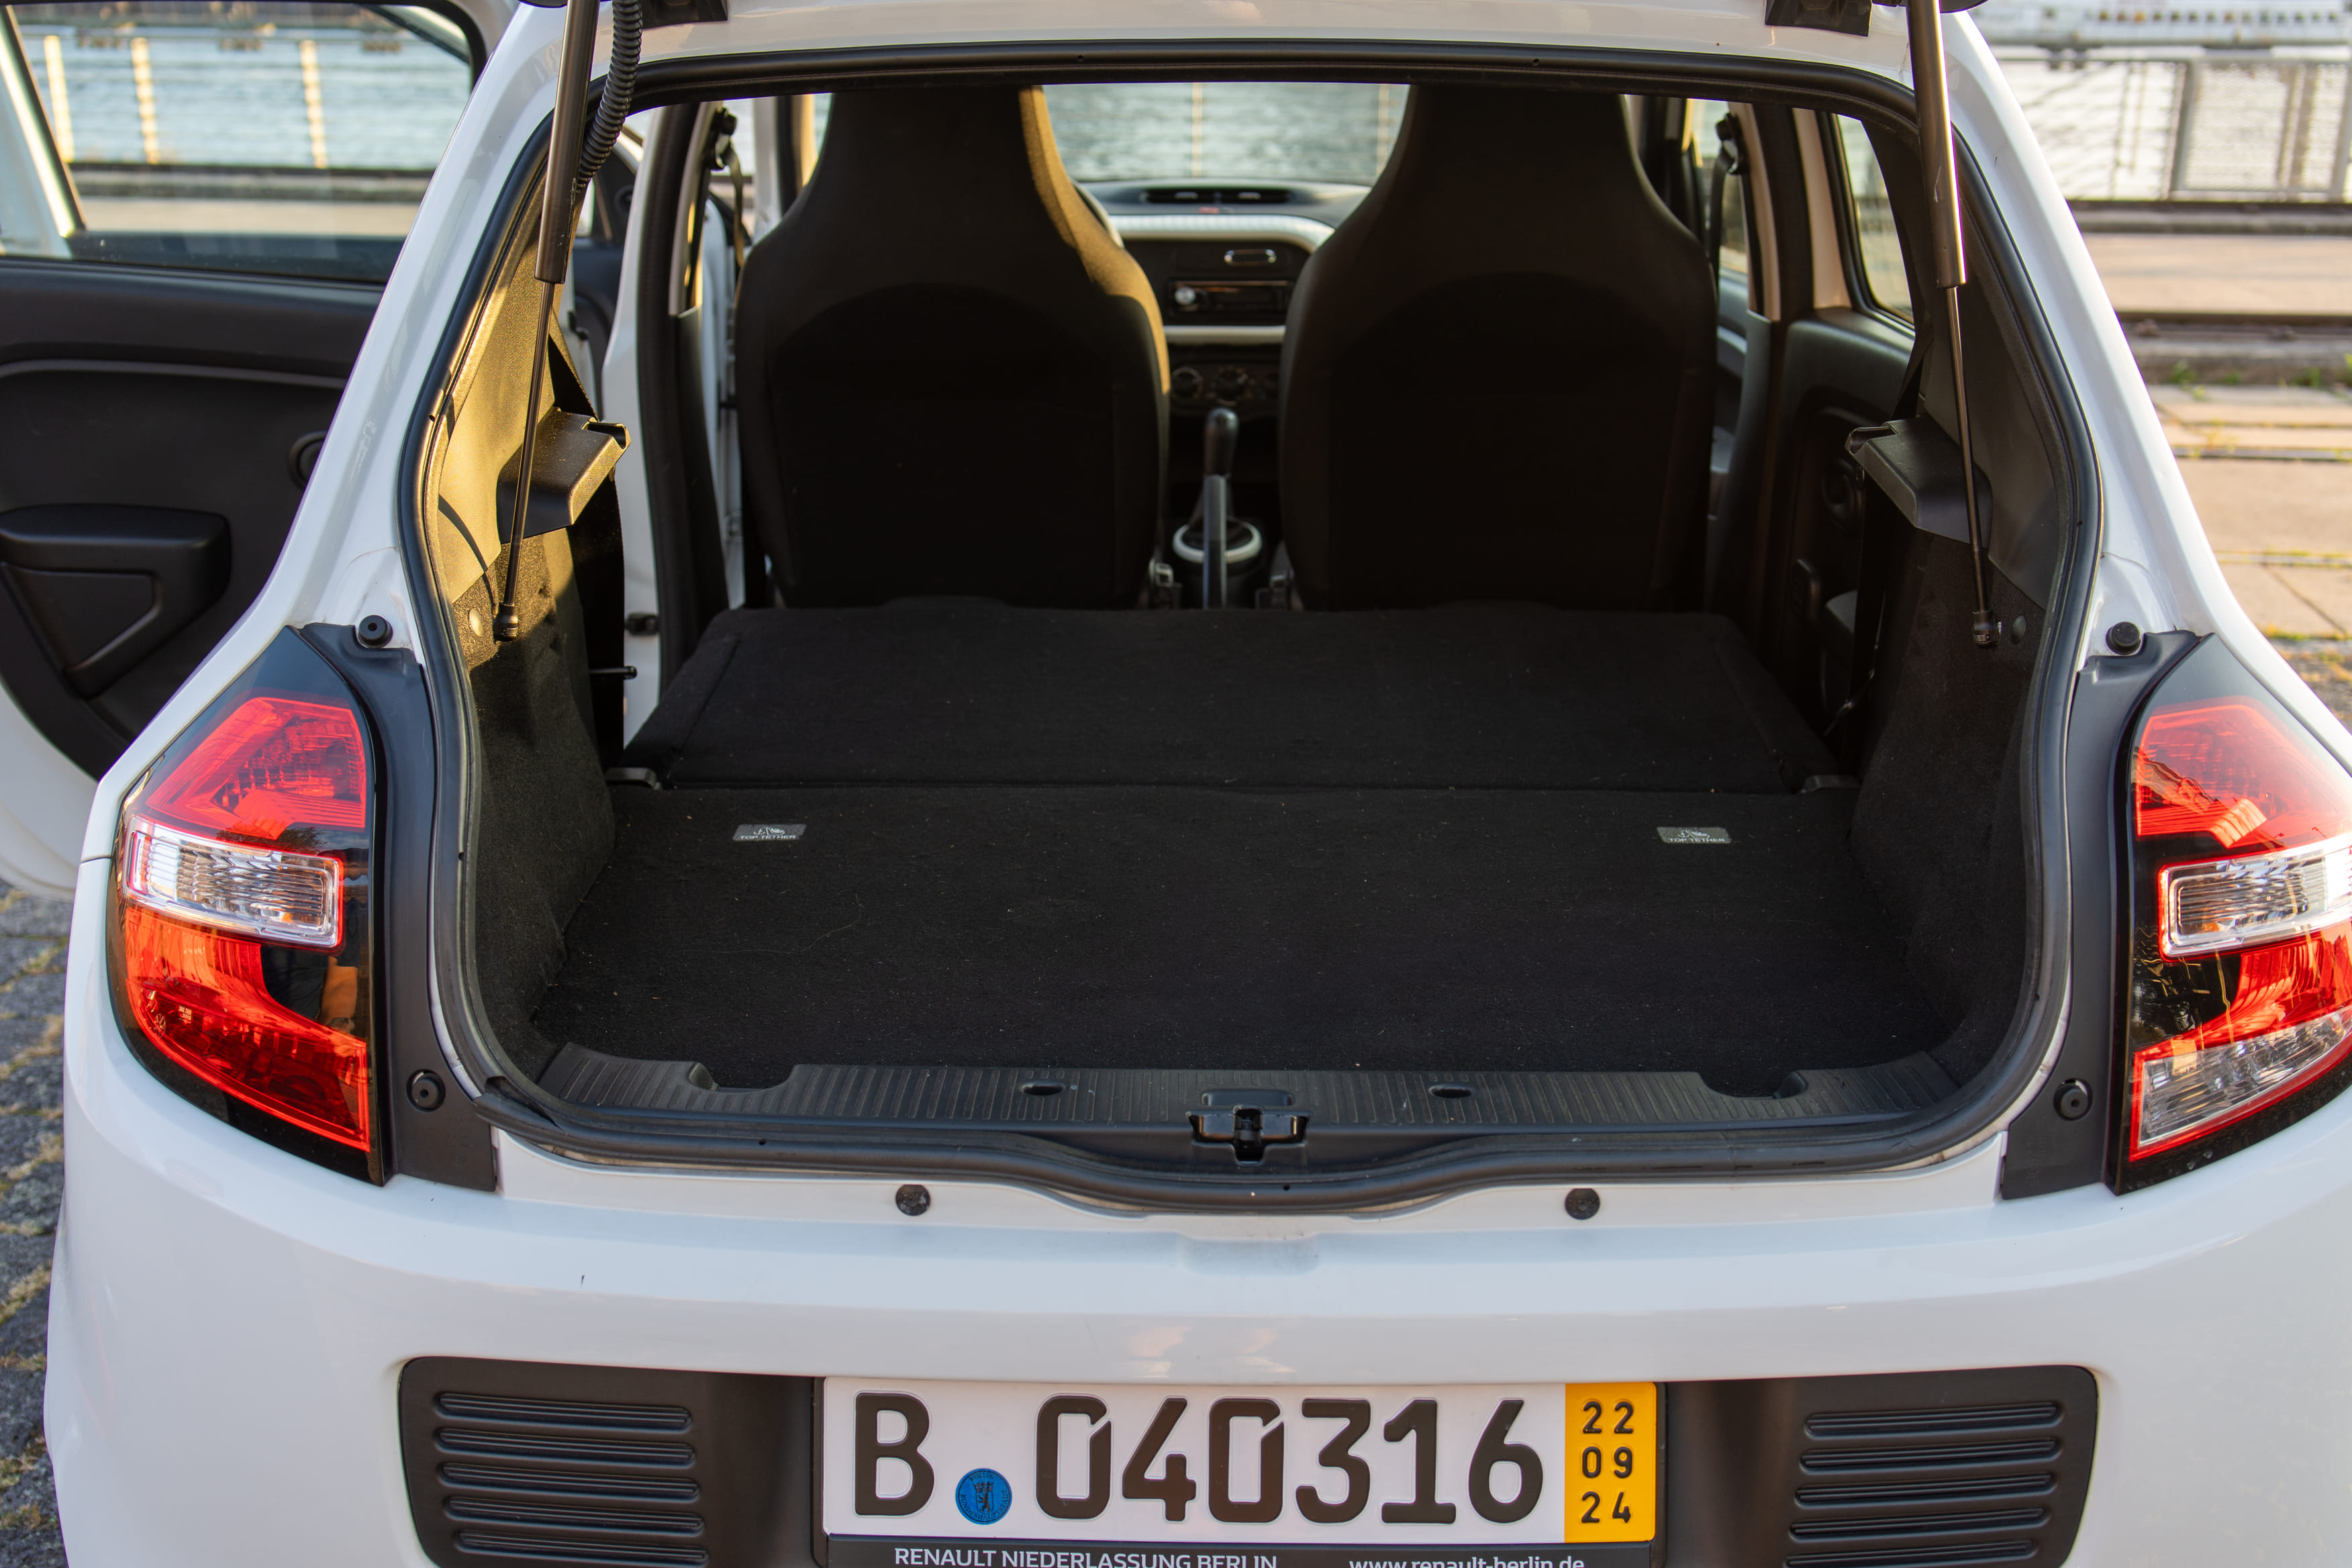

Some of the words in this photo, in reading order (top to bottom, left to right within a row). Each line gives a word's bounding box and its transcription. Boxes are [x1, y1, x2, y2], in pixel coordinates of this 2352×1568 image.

[1583, 1401, 1633, 1434] 22
[855, 1392, 934, 1516] B
[1036, 1395, 1543, 1524] 040316
[1582, 1446, 1632, 1479] 09
[1581, 1491, 1631, 1524] 24
[894, 1548, 997, 1567] RENAULT
[1001, 1551, 1191, 1568] NIEDERLASSUNG
[1349, 1556, 1585, 1568] wwwrenault-berlinde
